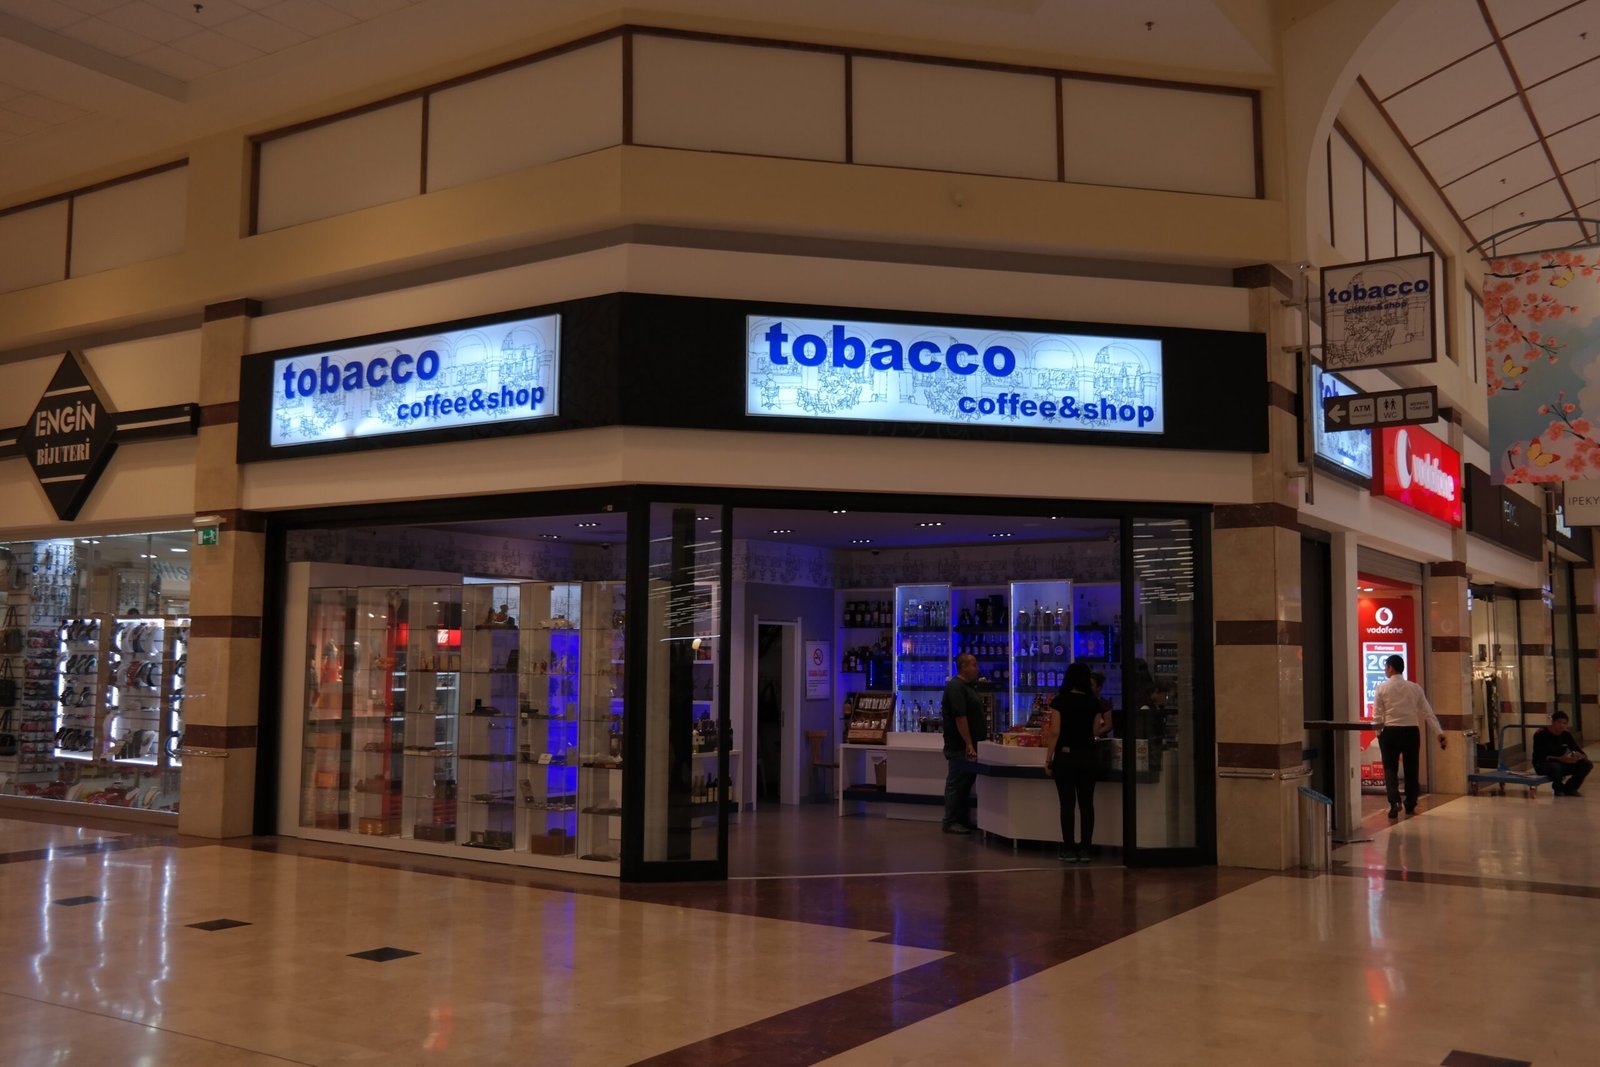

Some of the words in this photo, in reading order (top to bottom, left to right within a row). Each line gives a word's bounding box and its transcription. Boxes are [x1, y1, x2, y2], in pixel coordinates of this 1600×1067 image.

[1328, 279, 1429, 304] tobacco
[765, 321, 1016, 378] tobacco
[283, 349, 440, 400] tobacco
[397, 385, 545, 421] coffee&shop
[958, 392, 1155, 428] coffee&shop
[1353, 404, 1371, 413] ATM
[1383, 411, 1398, 419] WC
[35, 400, 96, 437] ENGİN
[36, 437, 91, 466] BİJUTERİ
[1568, 496, 1600, 506] IPEKY
[1366, 626, 1404, 634] vodafone
